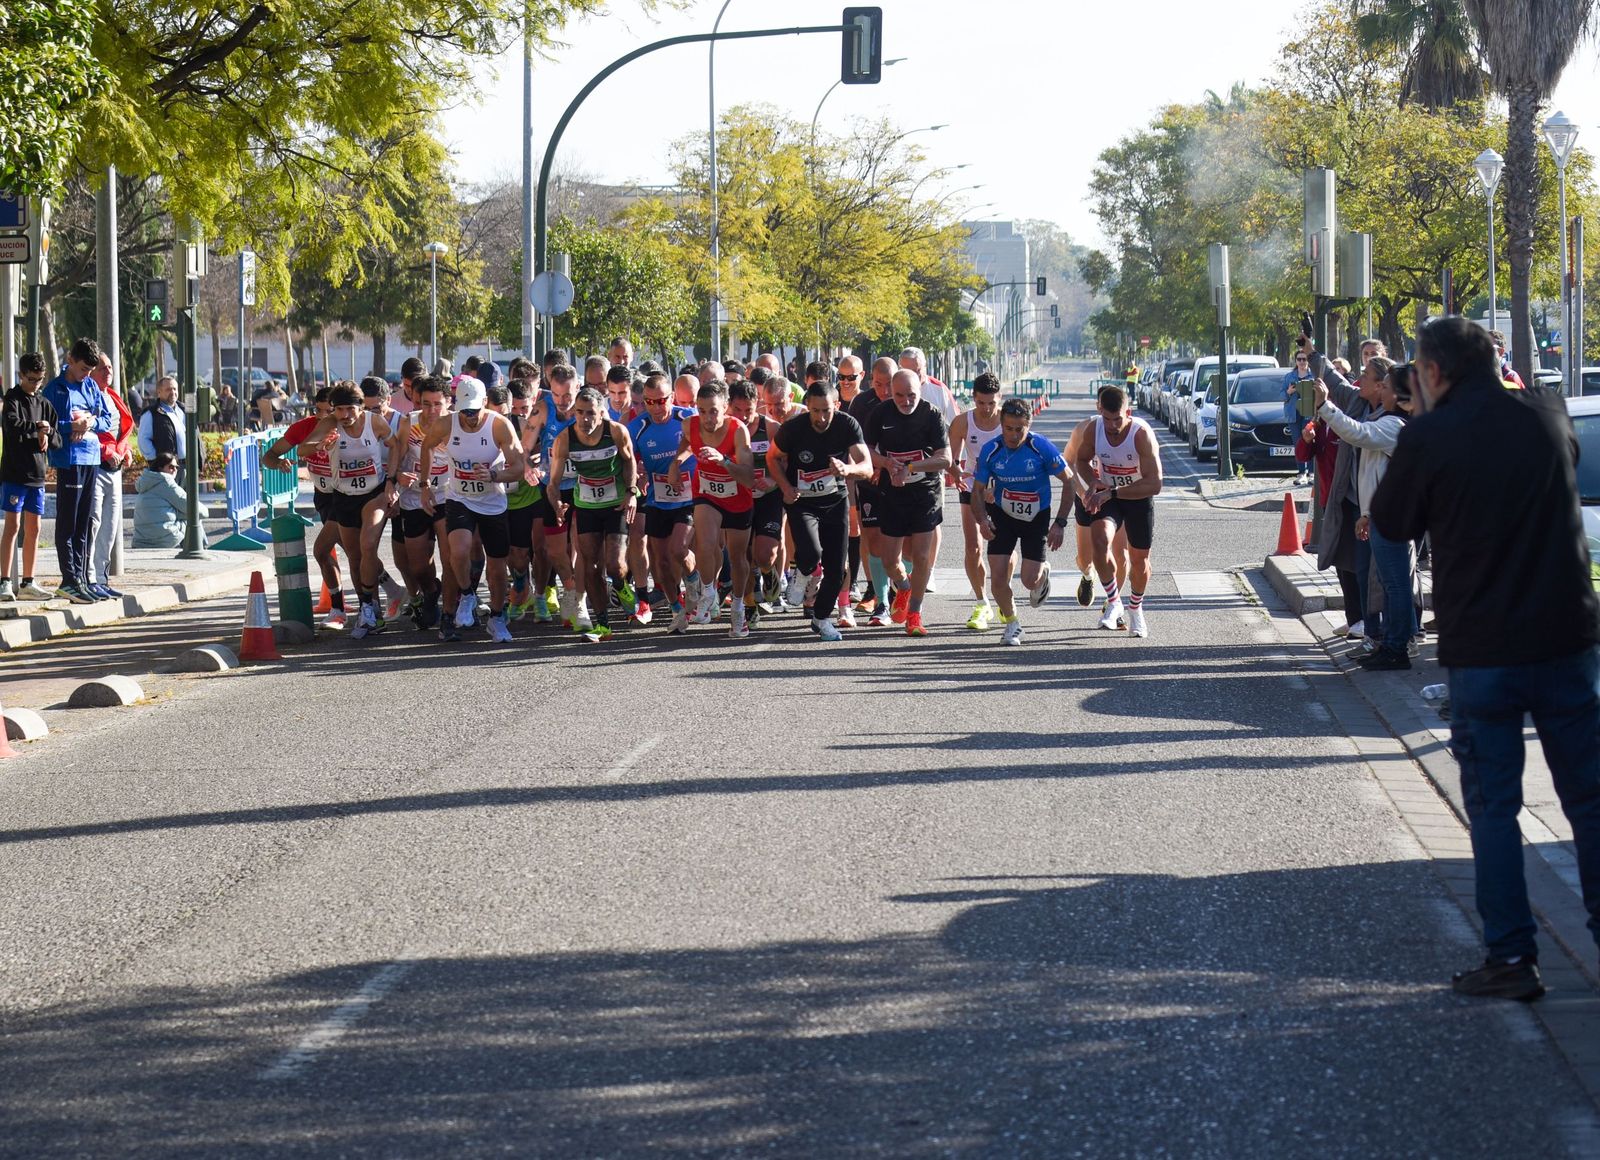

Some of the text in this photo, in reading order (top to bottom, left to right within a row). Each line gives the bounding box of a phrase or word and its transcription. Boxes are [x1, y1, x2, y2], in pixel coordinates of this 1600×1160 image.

[350, 476, 367, 489] 48
[461, 481, 485, 493] 216
[709, 482, 725, 493] 88
[809, 480, 825, 493] 46
[1110, 475, 1134, 488] 138
[591, 487, 605, 498] 18
[1009, 502, 1033, 515] 134
